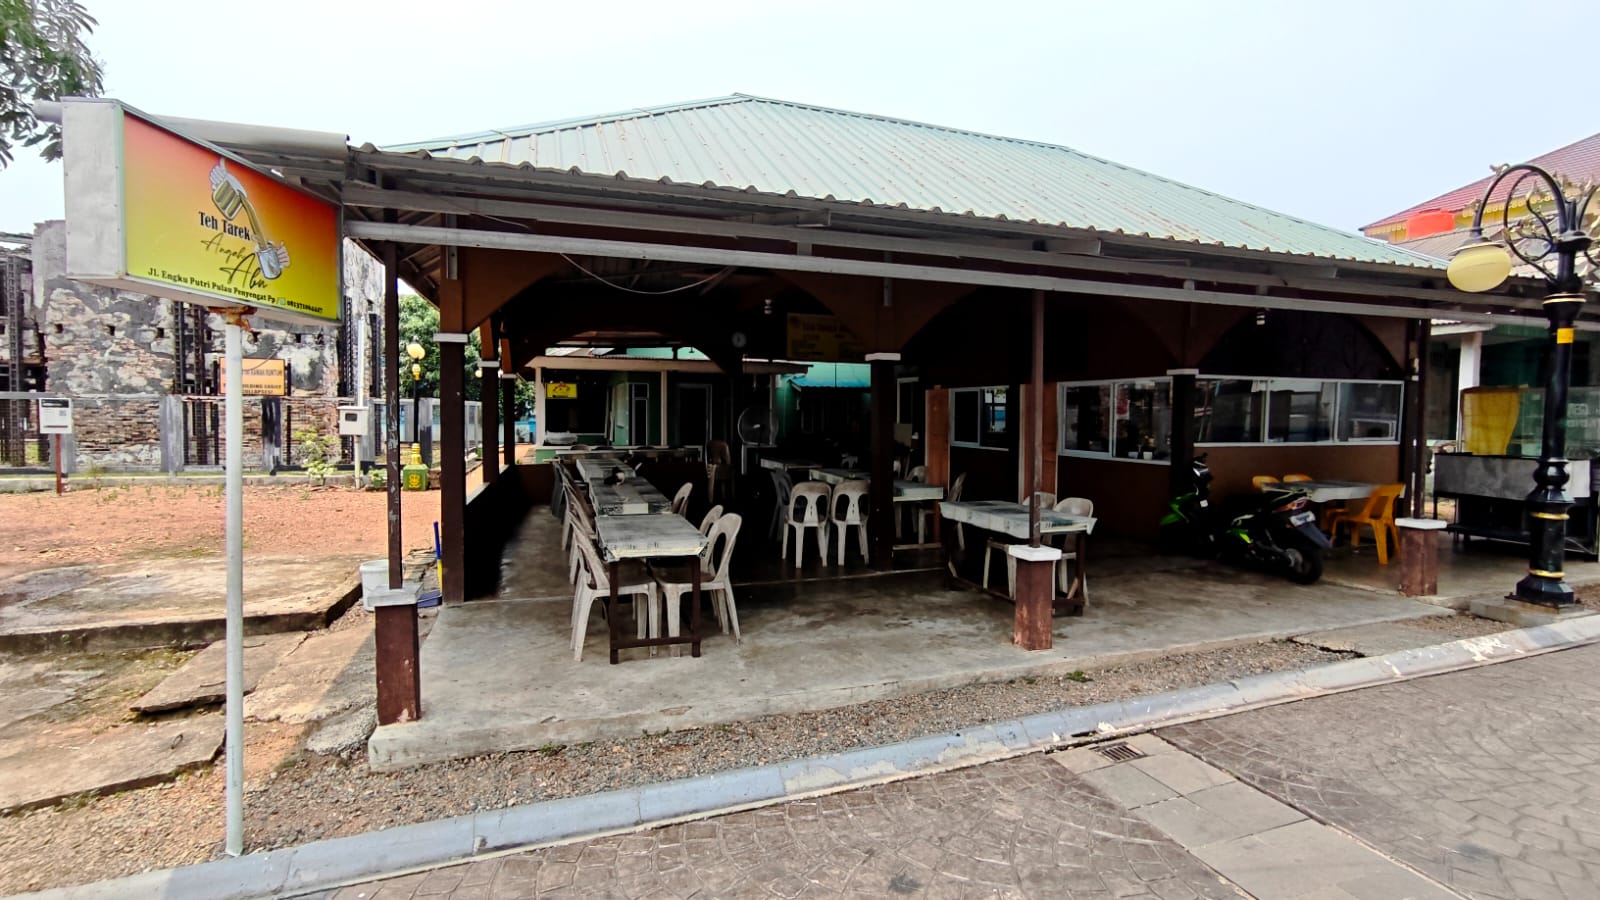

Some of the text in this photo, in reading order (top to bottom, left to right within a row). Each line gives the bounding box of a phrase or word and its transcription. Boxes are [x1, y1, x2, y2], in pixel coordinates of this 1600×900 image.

[198, 211, 250, 241] Teh Tarek
[161, 270, 188, 284] Engku
[190, 276, 210, 289] Putri
[211, 281, 232, 294] Pulau
[233, 287, 266, 301] Penyengat
